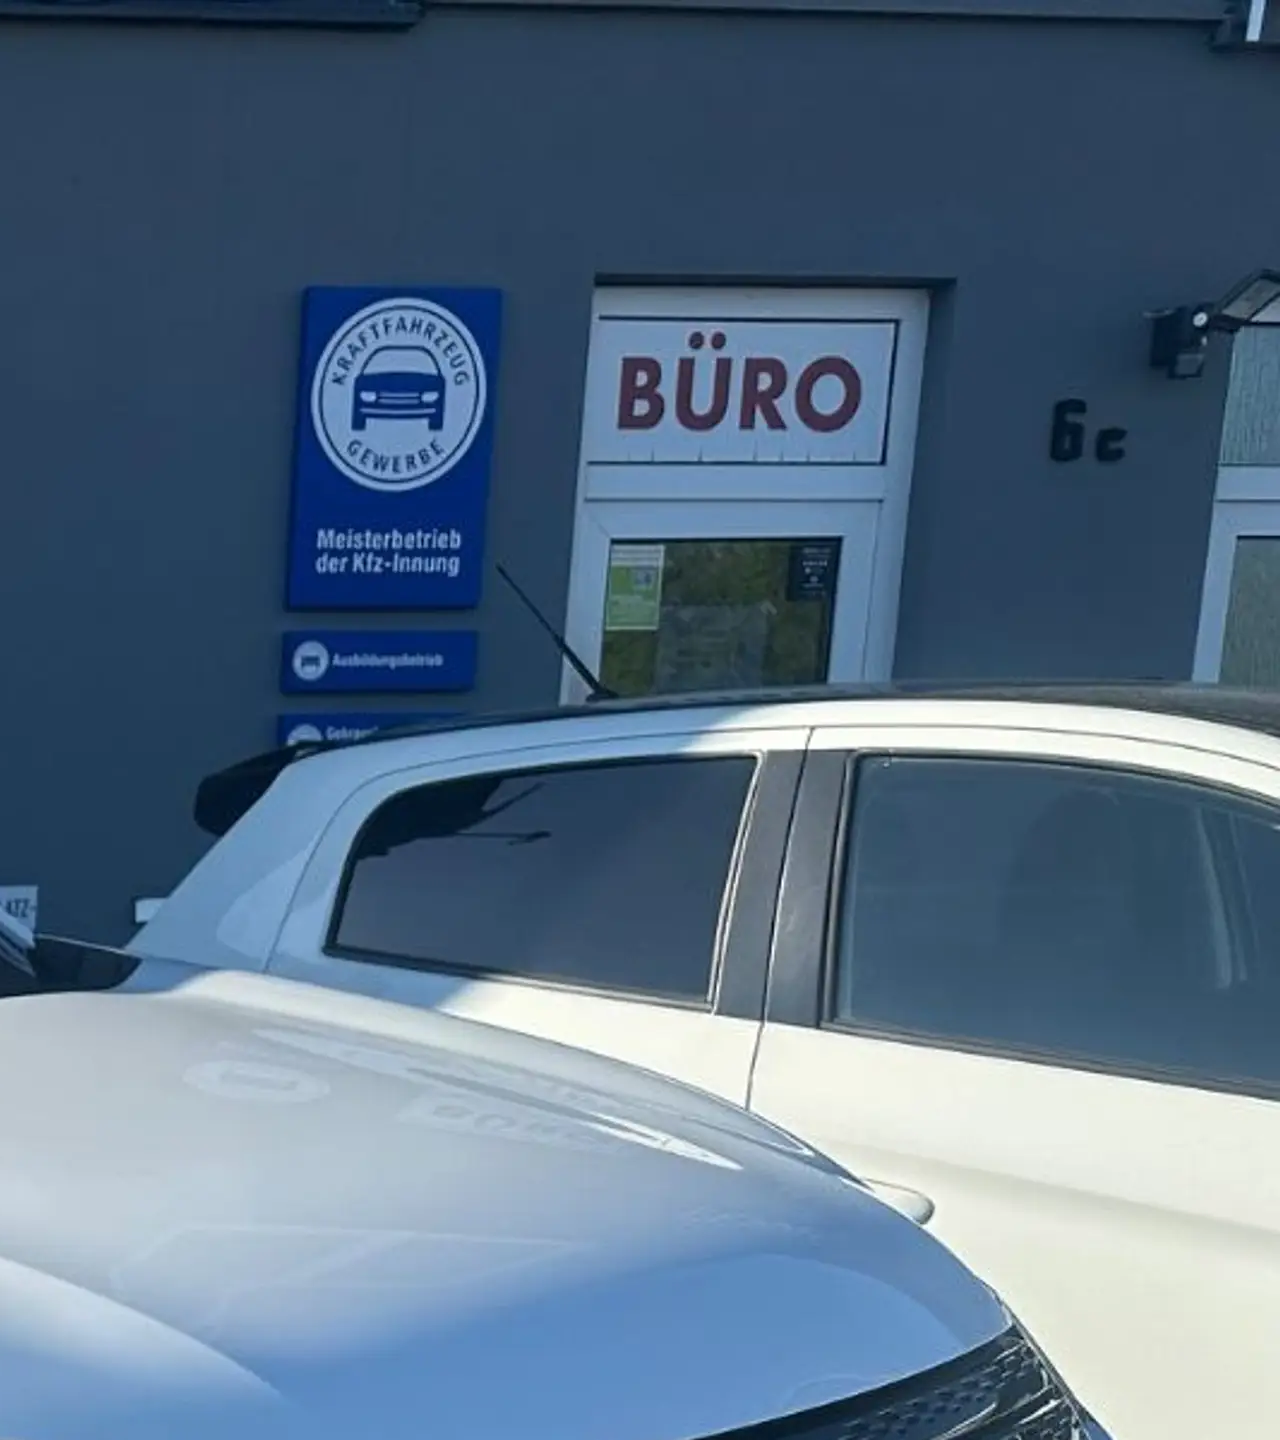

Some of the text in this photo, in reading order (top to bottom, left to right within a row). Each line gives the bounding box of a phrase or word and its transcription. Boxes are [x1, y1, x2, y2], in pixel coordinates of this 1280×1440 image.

[331, 315, 471, 387] KRAFTFAHRZEUG
[617, 330, 863, 433] BÜRO
[346, 438, 445, 474] GEWERBE
[316, 527, 462, 549] Meisterbetrieb
[315, 551, 461, 578] der Kfz-Innung
[331, 651, 444, 670] Ausbildungsbetrieb
